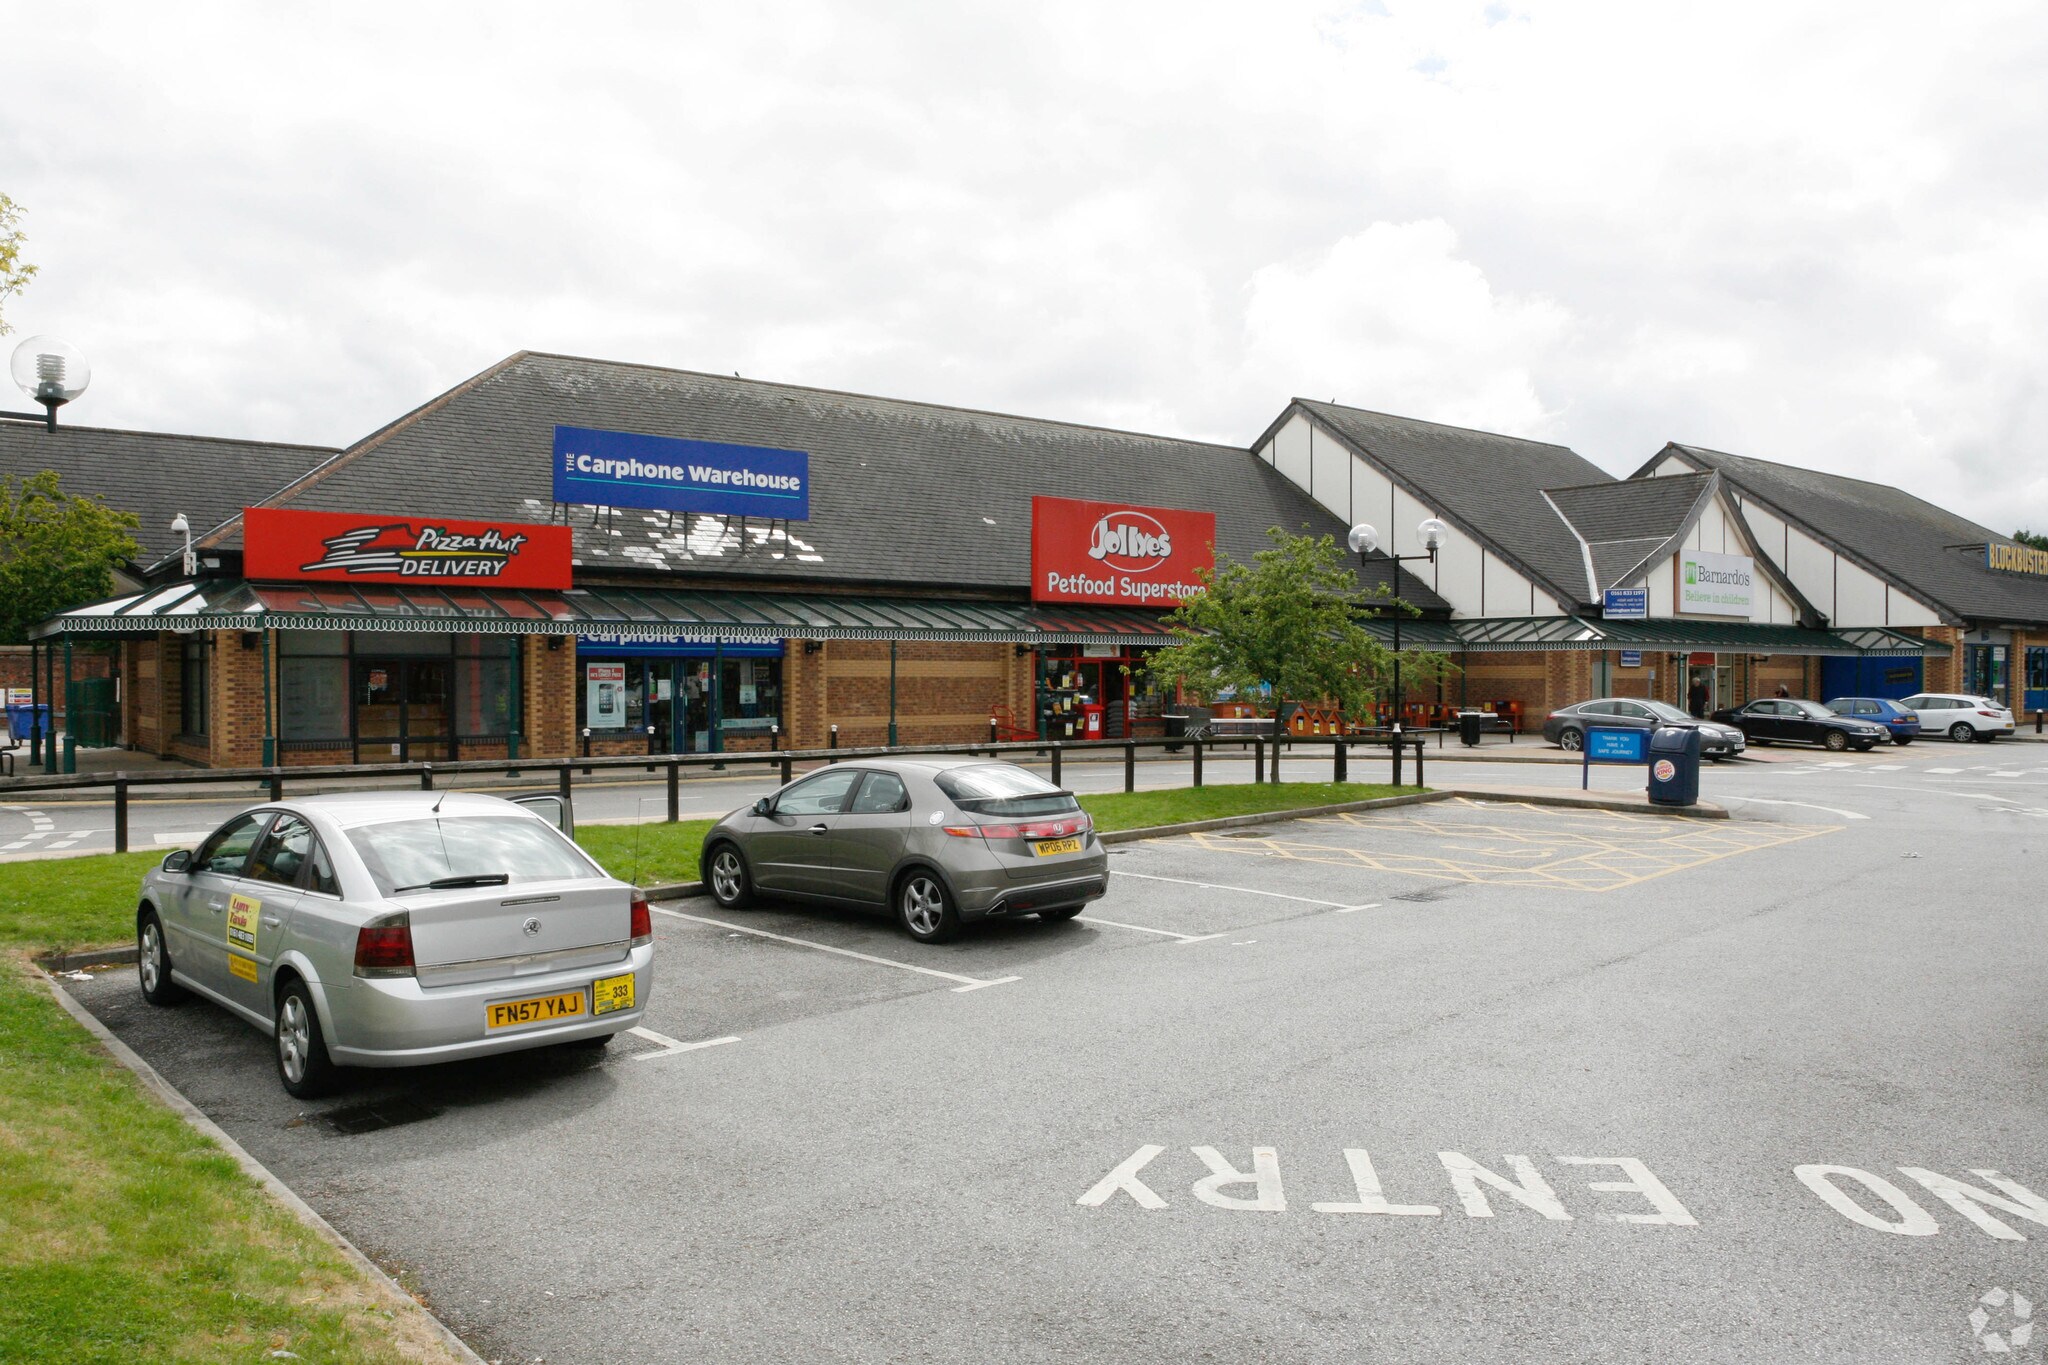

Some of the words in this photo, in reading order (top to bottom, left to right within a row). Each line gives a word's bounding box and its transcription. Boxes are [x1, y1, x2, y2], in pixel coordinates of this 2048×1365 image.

[566, 452, 575, 472] THE
[577, 454, 684, 479] Carphone
[688, 465, 801, 491] Warehouse
[416, 526, 477, 551] Pizza
[477, 530, 527, 552] Hut
[1088, 519, 1172, 560] Jollyes
[401, 559, 507, 576] DELIVERY
[1698, 565, 1750, 587] Barnardo's
[1048, 572, 1115, 596] Petfood
[1685, 590, 1711, 603] Believe
[1712, 593, 1720, 604] in
[1721, 593, 1750, 606] children
[1039, 841, 1062, 854] WP06
[1062, 839, 1078, 851] RPZ
[612, 984, 628, 999] 333
[495, 1001, 541, 1025] FN57
[546, 996, 579, 1016] YAJ
[1073, 1144, 1699, 1227] ENTRY
[1793, 1163, 2048, 1241] NO
